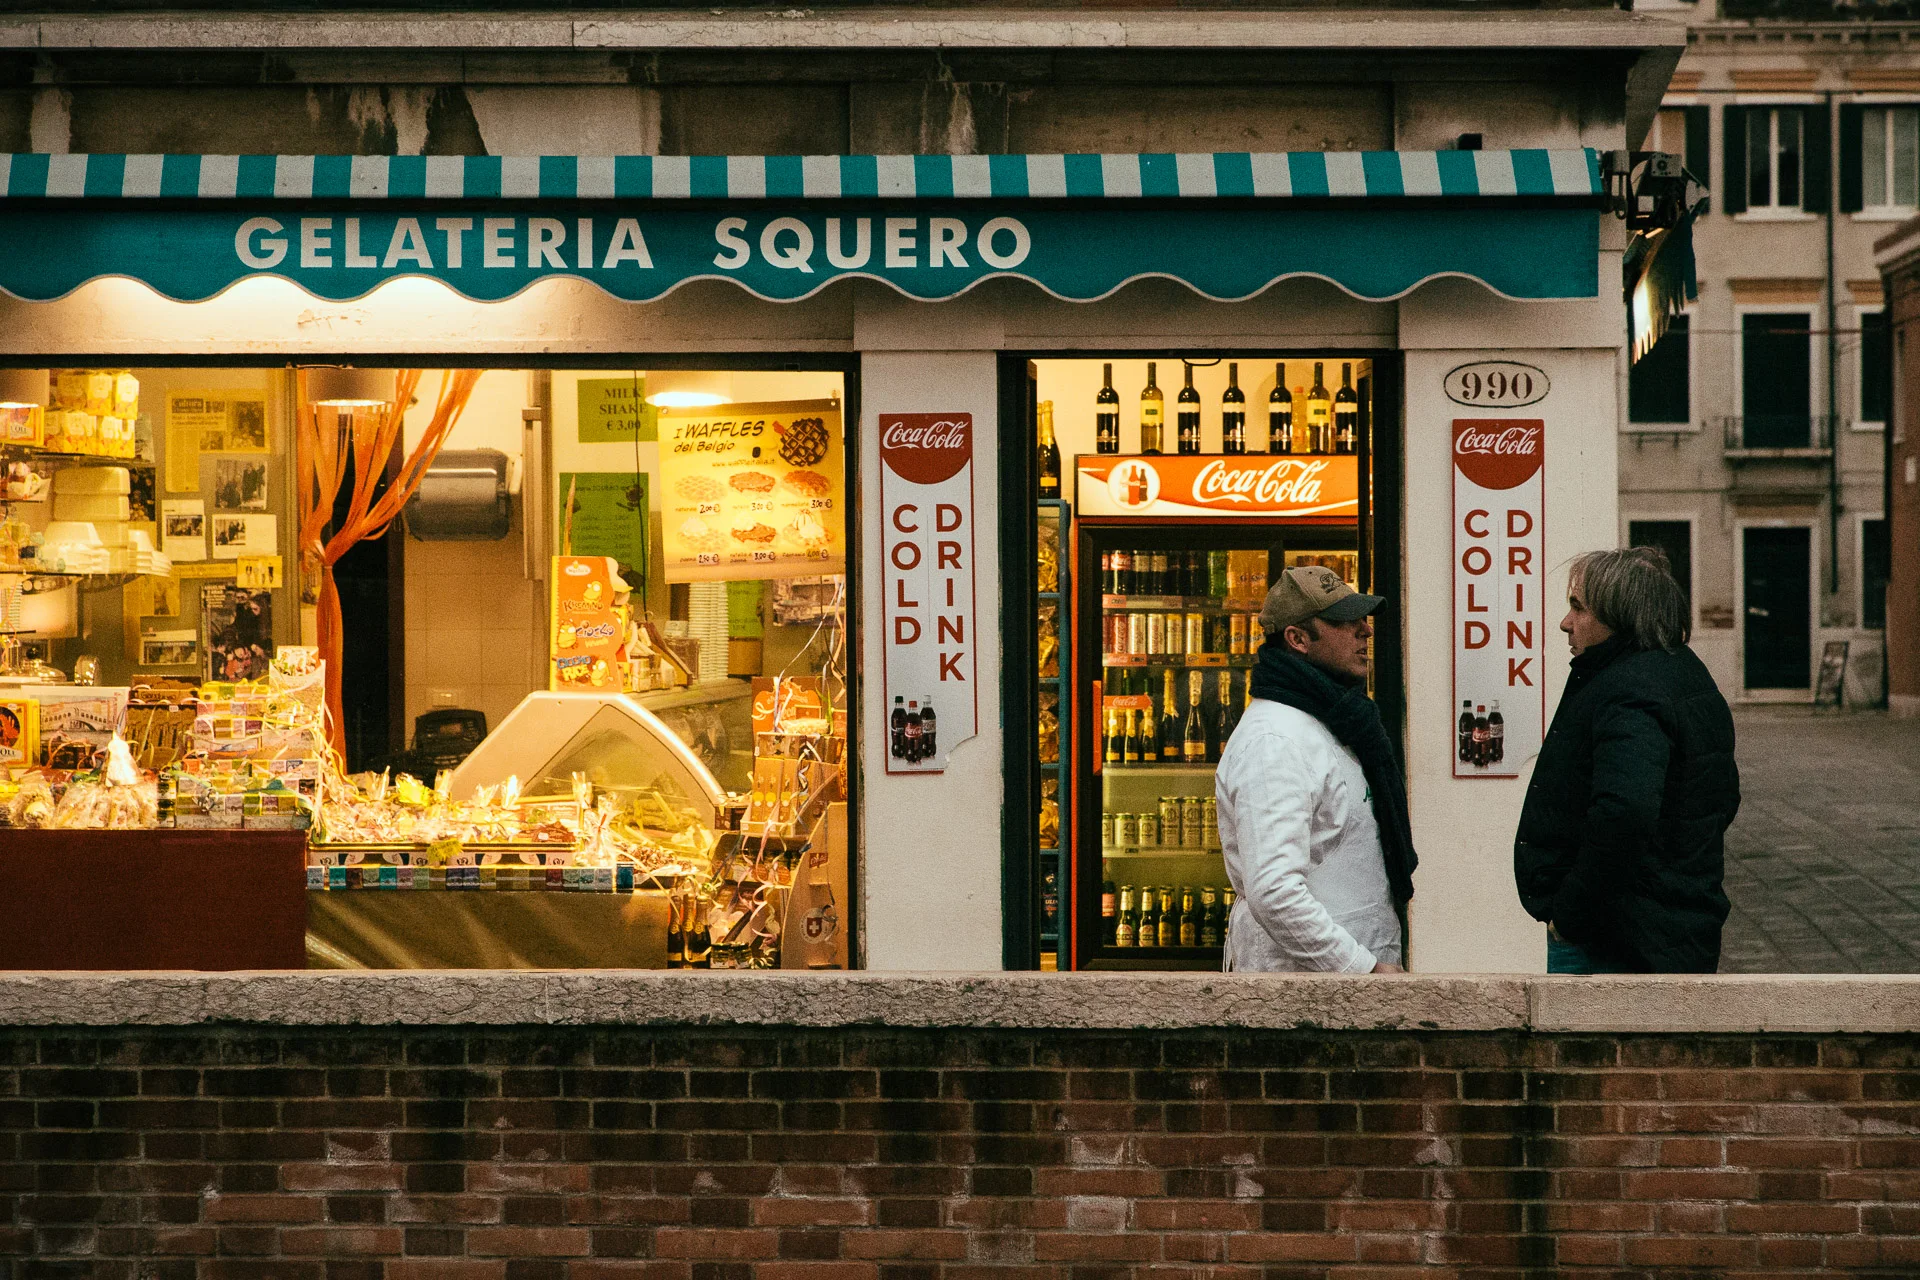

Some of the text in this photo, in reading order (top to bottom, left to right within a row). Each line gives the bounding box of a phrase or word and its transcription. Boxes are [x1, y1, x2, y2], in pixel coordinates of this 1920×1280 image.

[234, 216, 1031, 274] GELATERIA SQUERO
[604, 388, 642, 399] MILK
[1461, 371, 1533, 400] 990
[599, 403, 648, 415] SHAKE
[673, 420, 766, 439] I WAFFLES
[882, 420, 969, 450] Coca-Cola
[1455, 427, 1541, 455] Coca-Cola
[673, 440, 736, 454] del Belgio
[1191, 459, 1331, 504] Coca-Cola
[891, 503, 922, 645] COLD
[1461, 508, 1492, 650] COLD
[935, 503, 966, 682] DRINK
[1506, 509, 1535, 687] DRINK
